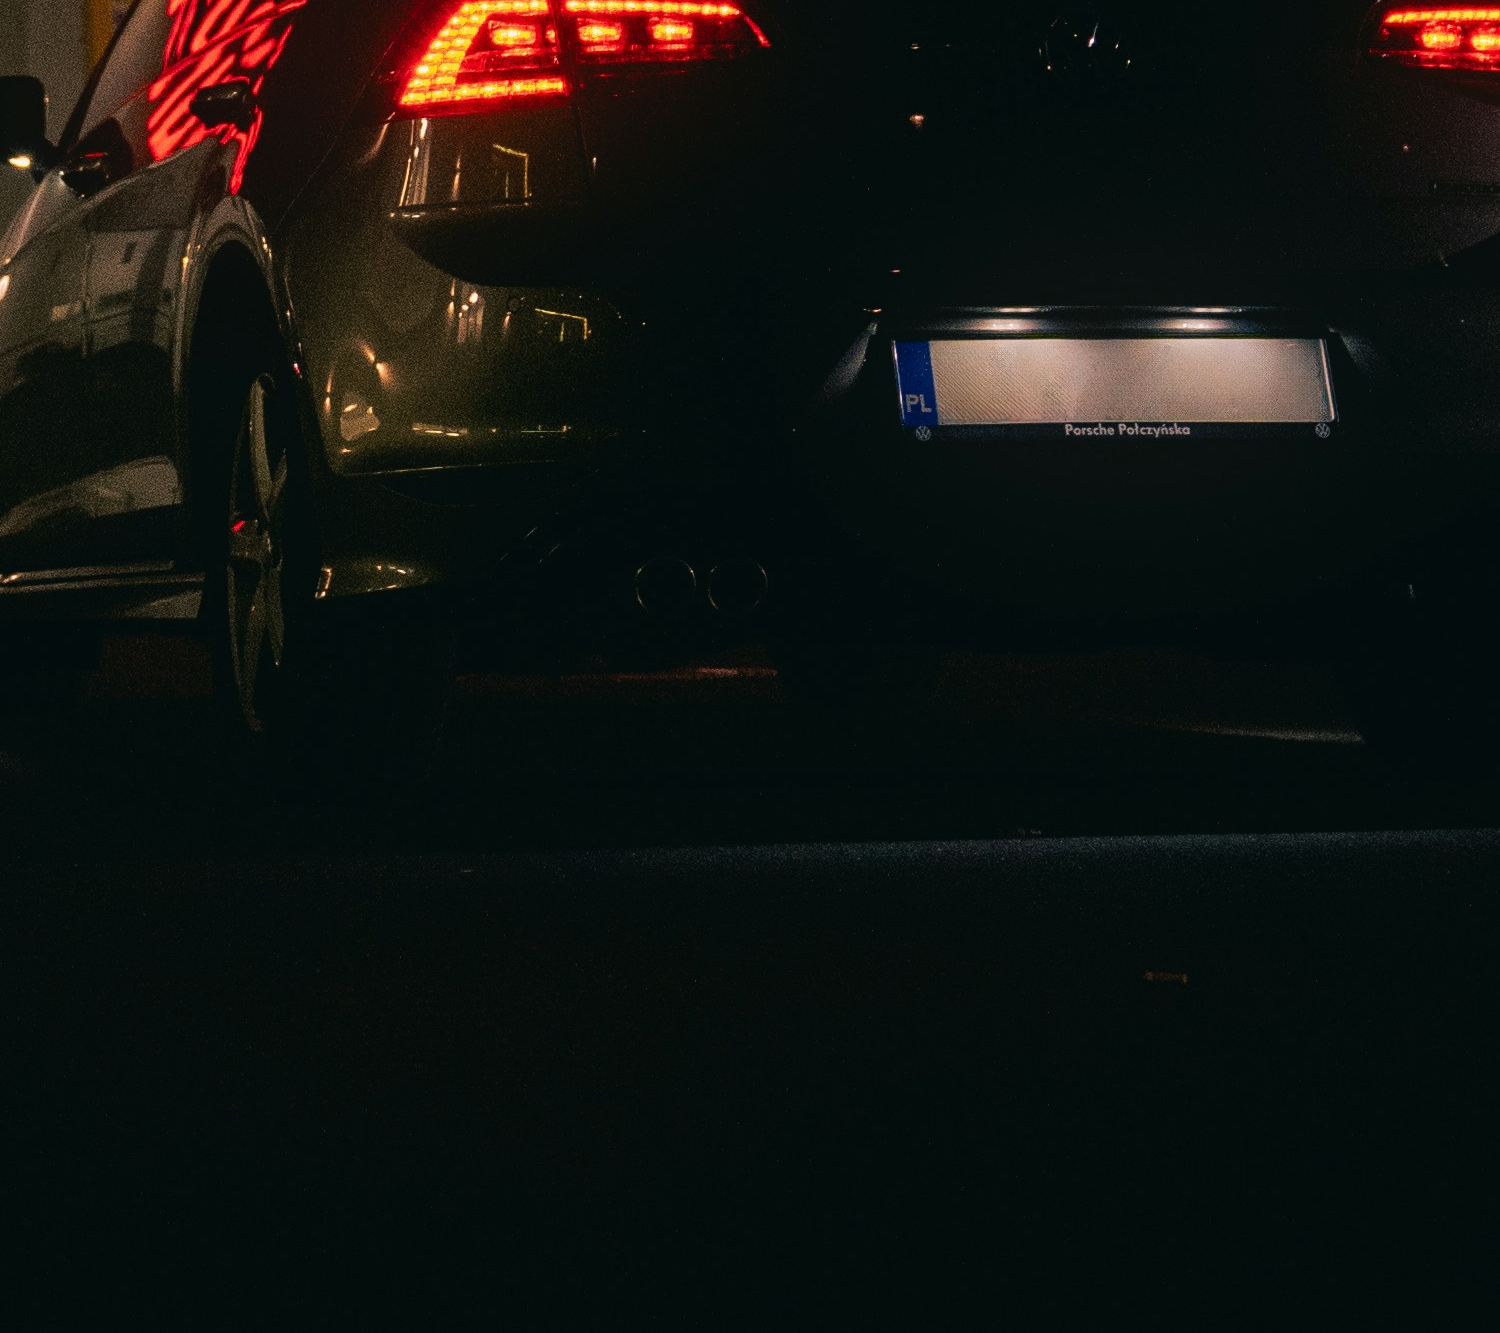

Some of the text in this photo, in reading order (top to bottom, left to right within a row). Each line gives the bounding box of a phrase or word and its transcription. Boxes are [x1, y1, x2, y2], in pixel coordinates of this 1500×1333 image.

[905, 393, 932, 413] PL
[1064, 422, 1191, 438] Porsche Połczyńska
